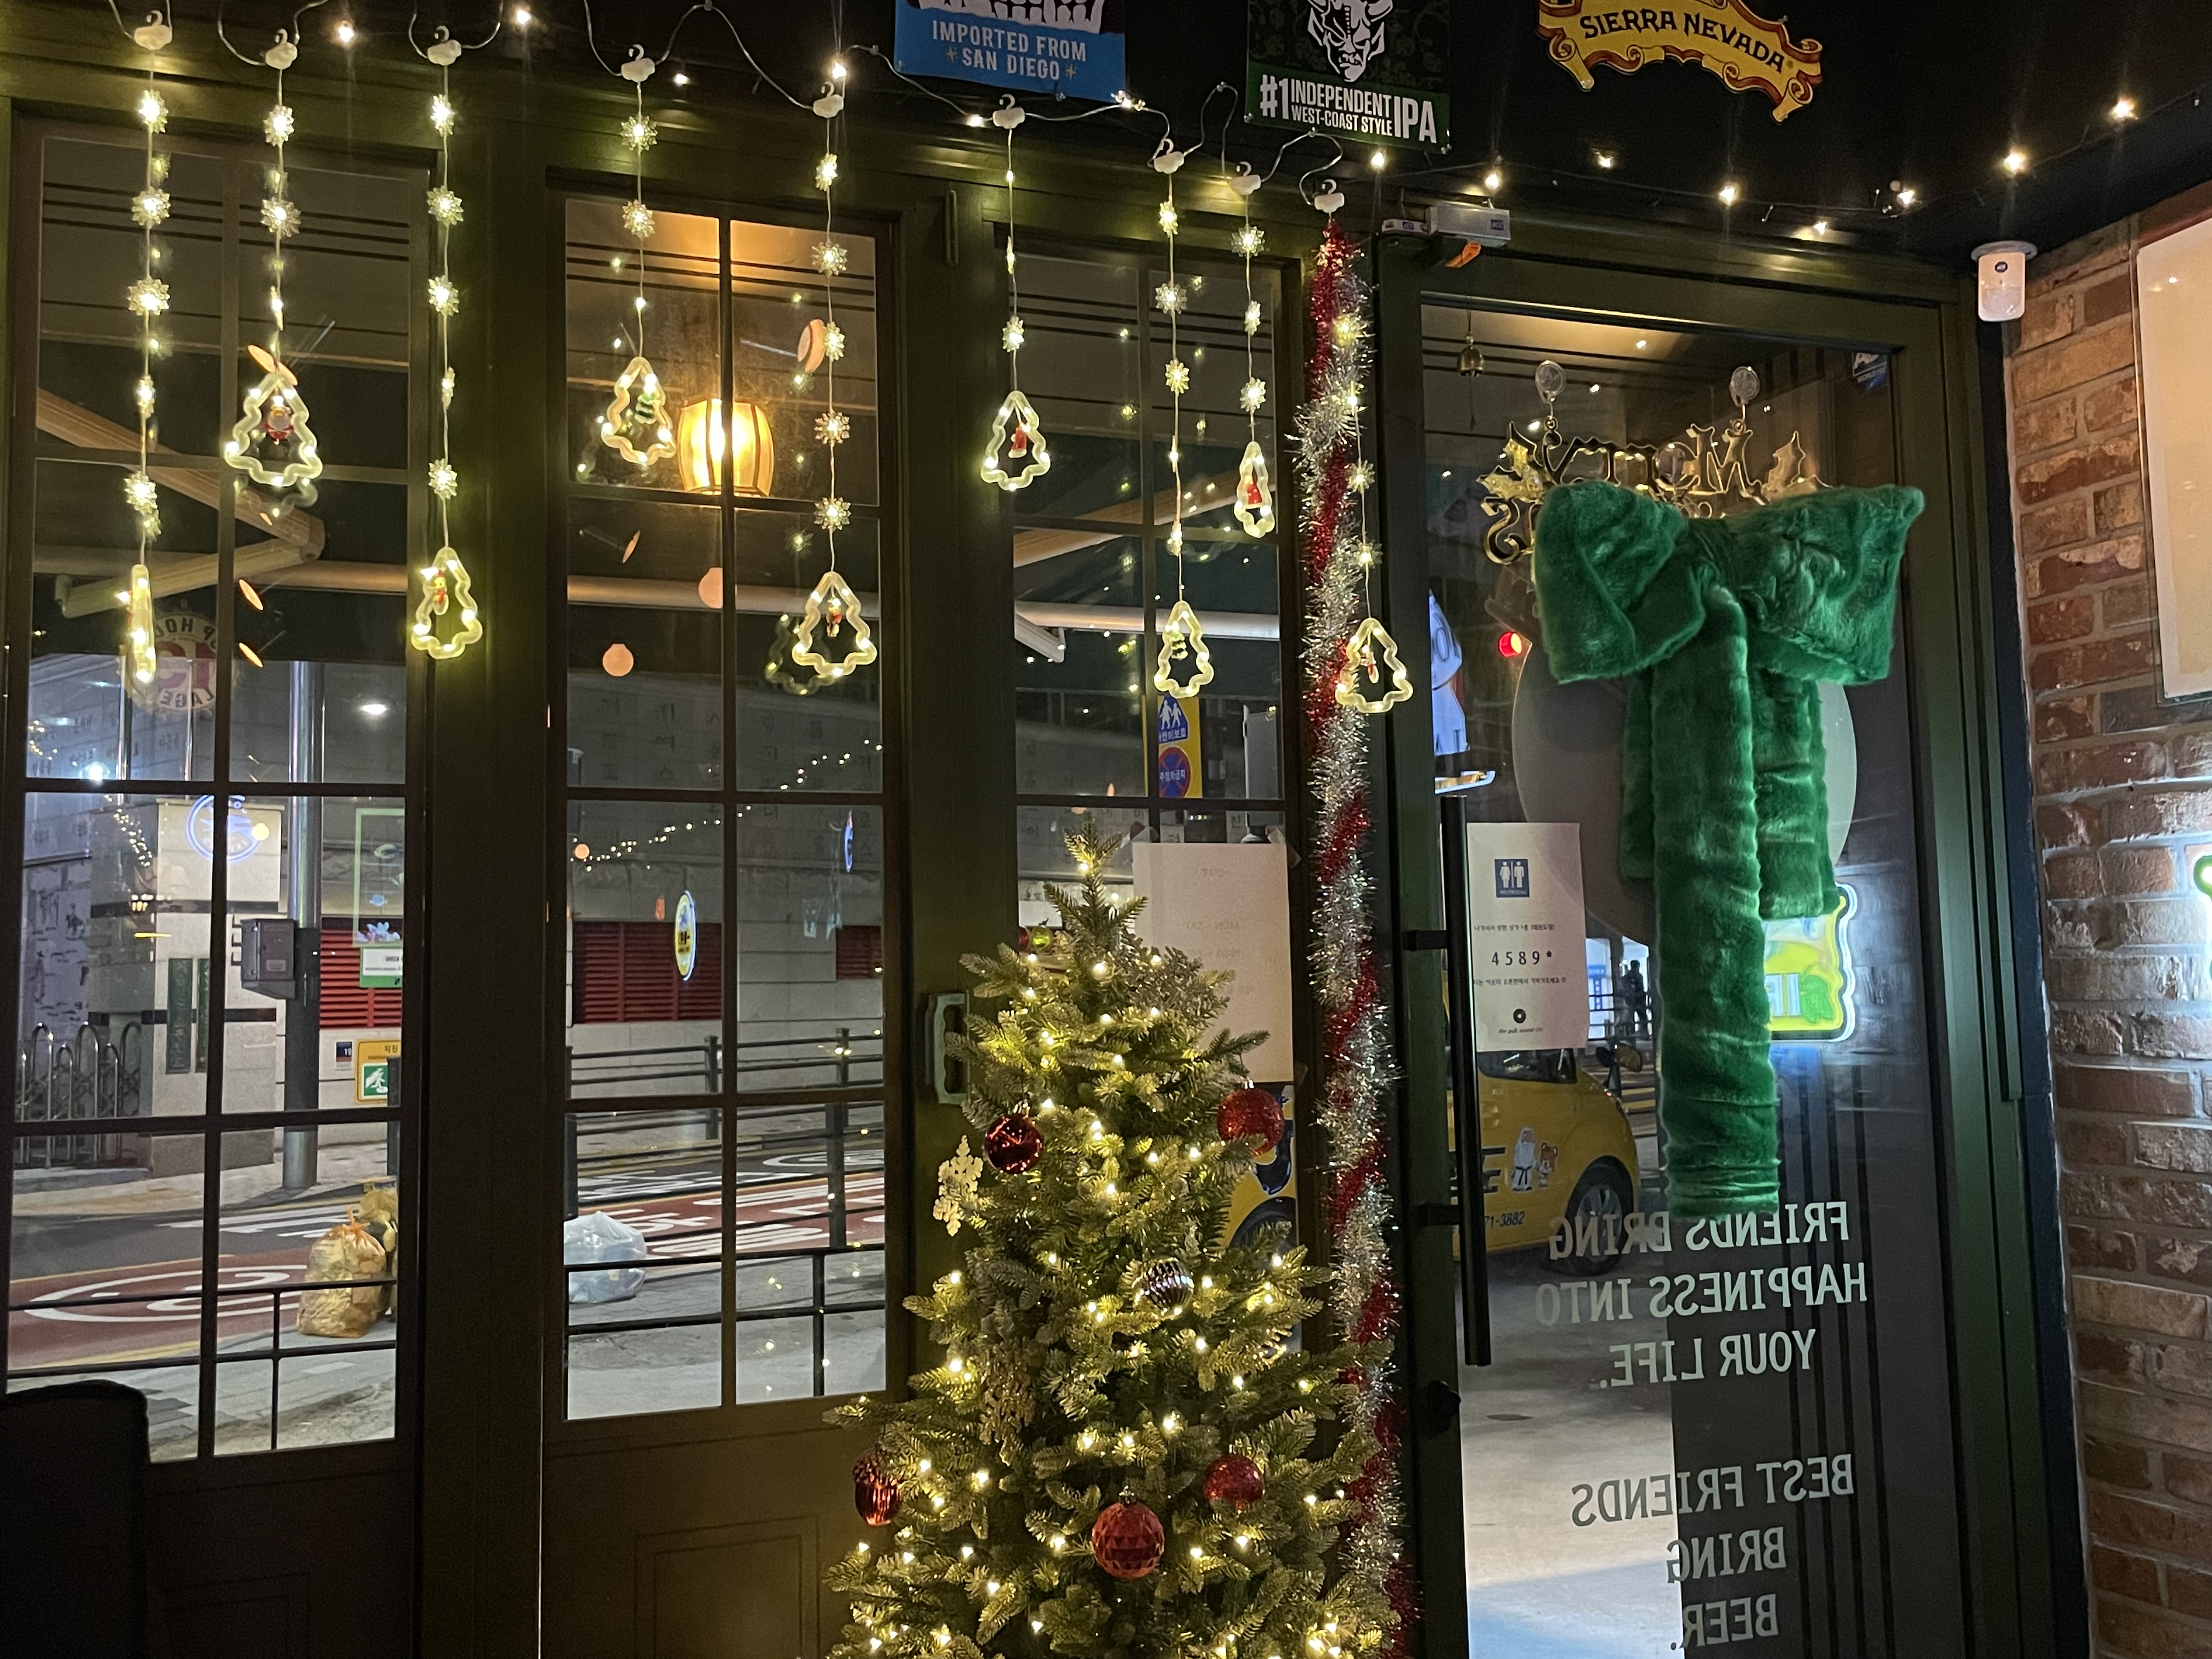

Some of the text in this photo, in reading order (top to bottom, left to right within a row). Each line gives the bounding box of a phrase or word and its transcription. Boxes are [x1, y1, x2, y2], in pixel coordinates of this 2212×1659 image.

[932, 20, 1086, 62] IMPORTED FROM
[1579, 9, 1785, 74] SIERRA NEVADA
[962, 47, 1060, 80] SAN DIEGO
[1260, 75, 1437, 143] #1 INDEPENDENT IPA
[1291, 105, 1393, 136] WEST-COAST STYLE
[1484, 1211, 1525, 1229] 71-3882
